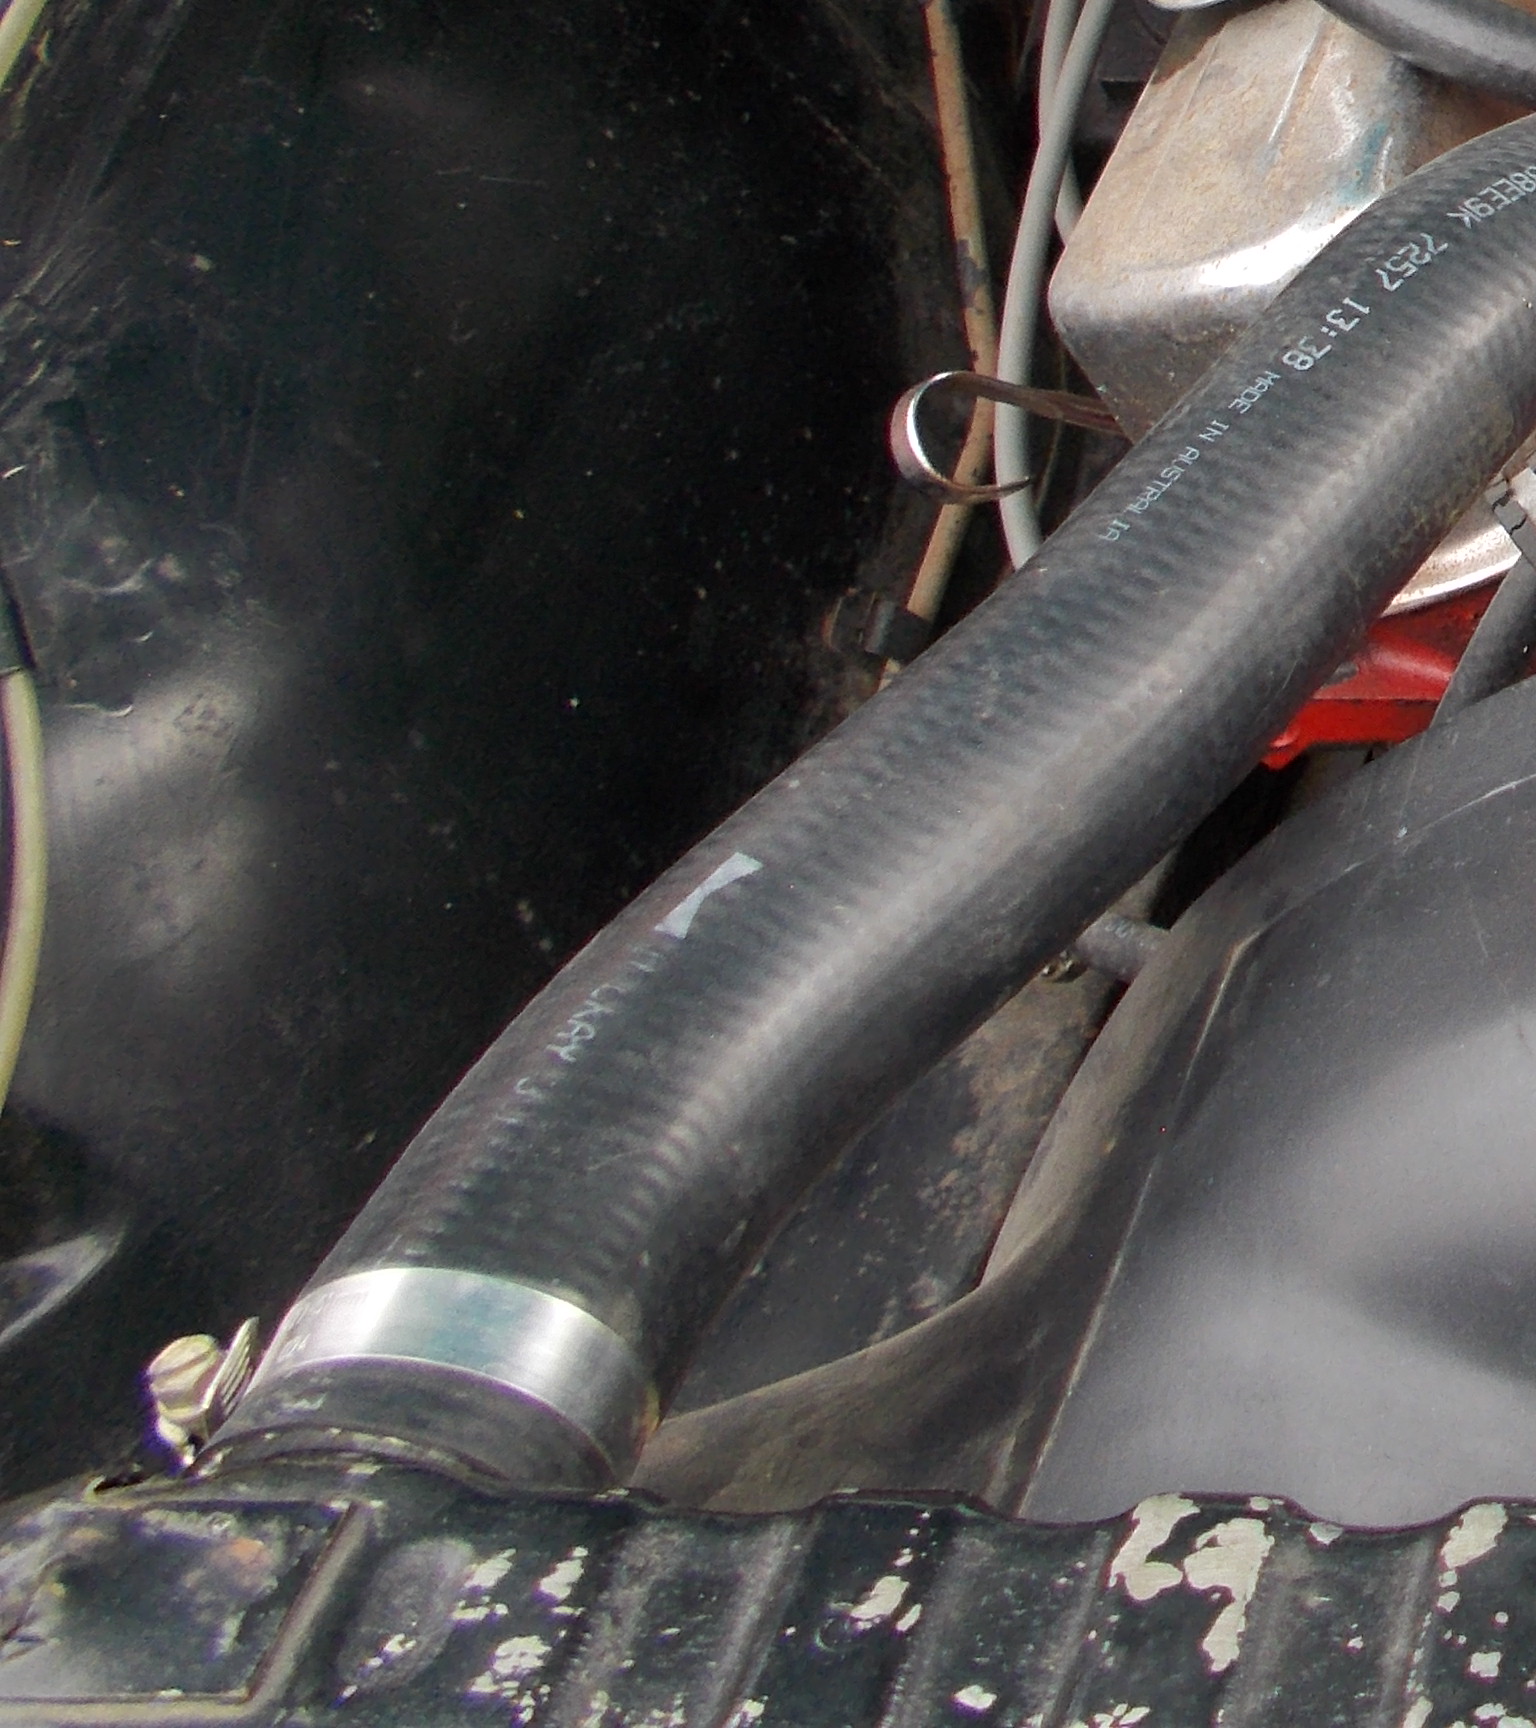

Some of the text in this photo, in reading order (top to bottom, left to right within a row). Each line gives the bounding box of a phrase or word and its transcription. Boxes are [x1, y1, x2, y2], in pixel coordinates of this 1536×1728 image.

[1375, 232, 1449, 292] 7257
[1281, 297, 1371, 371] 13:38
[1228, 371, 1282, 415] MADE
[1200, 420, 1231, 444] IN
[1100, 445, 1200, 542] AUSTRALIA
